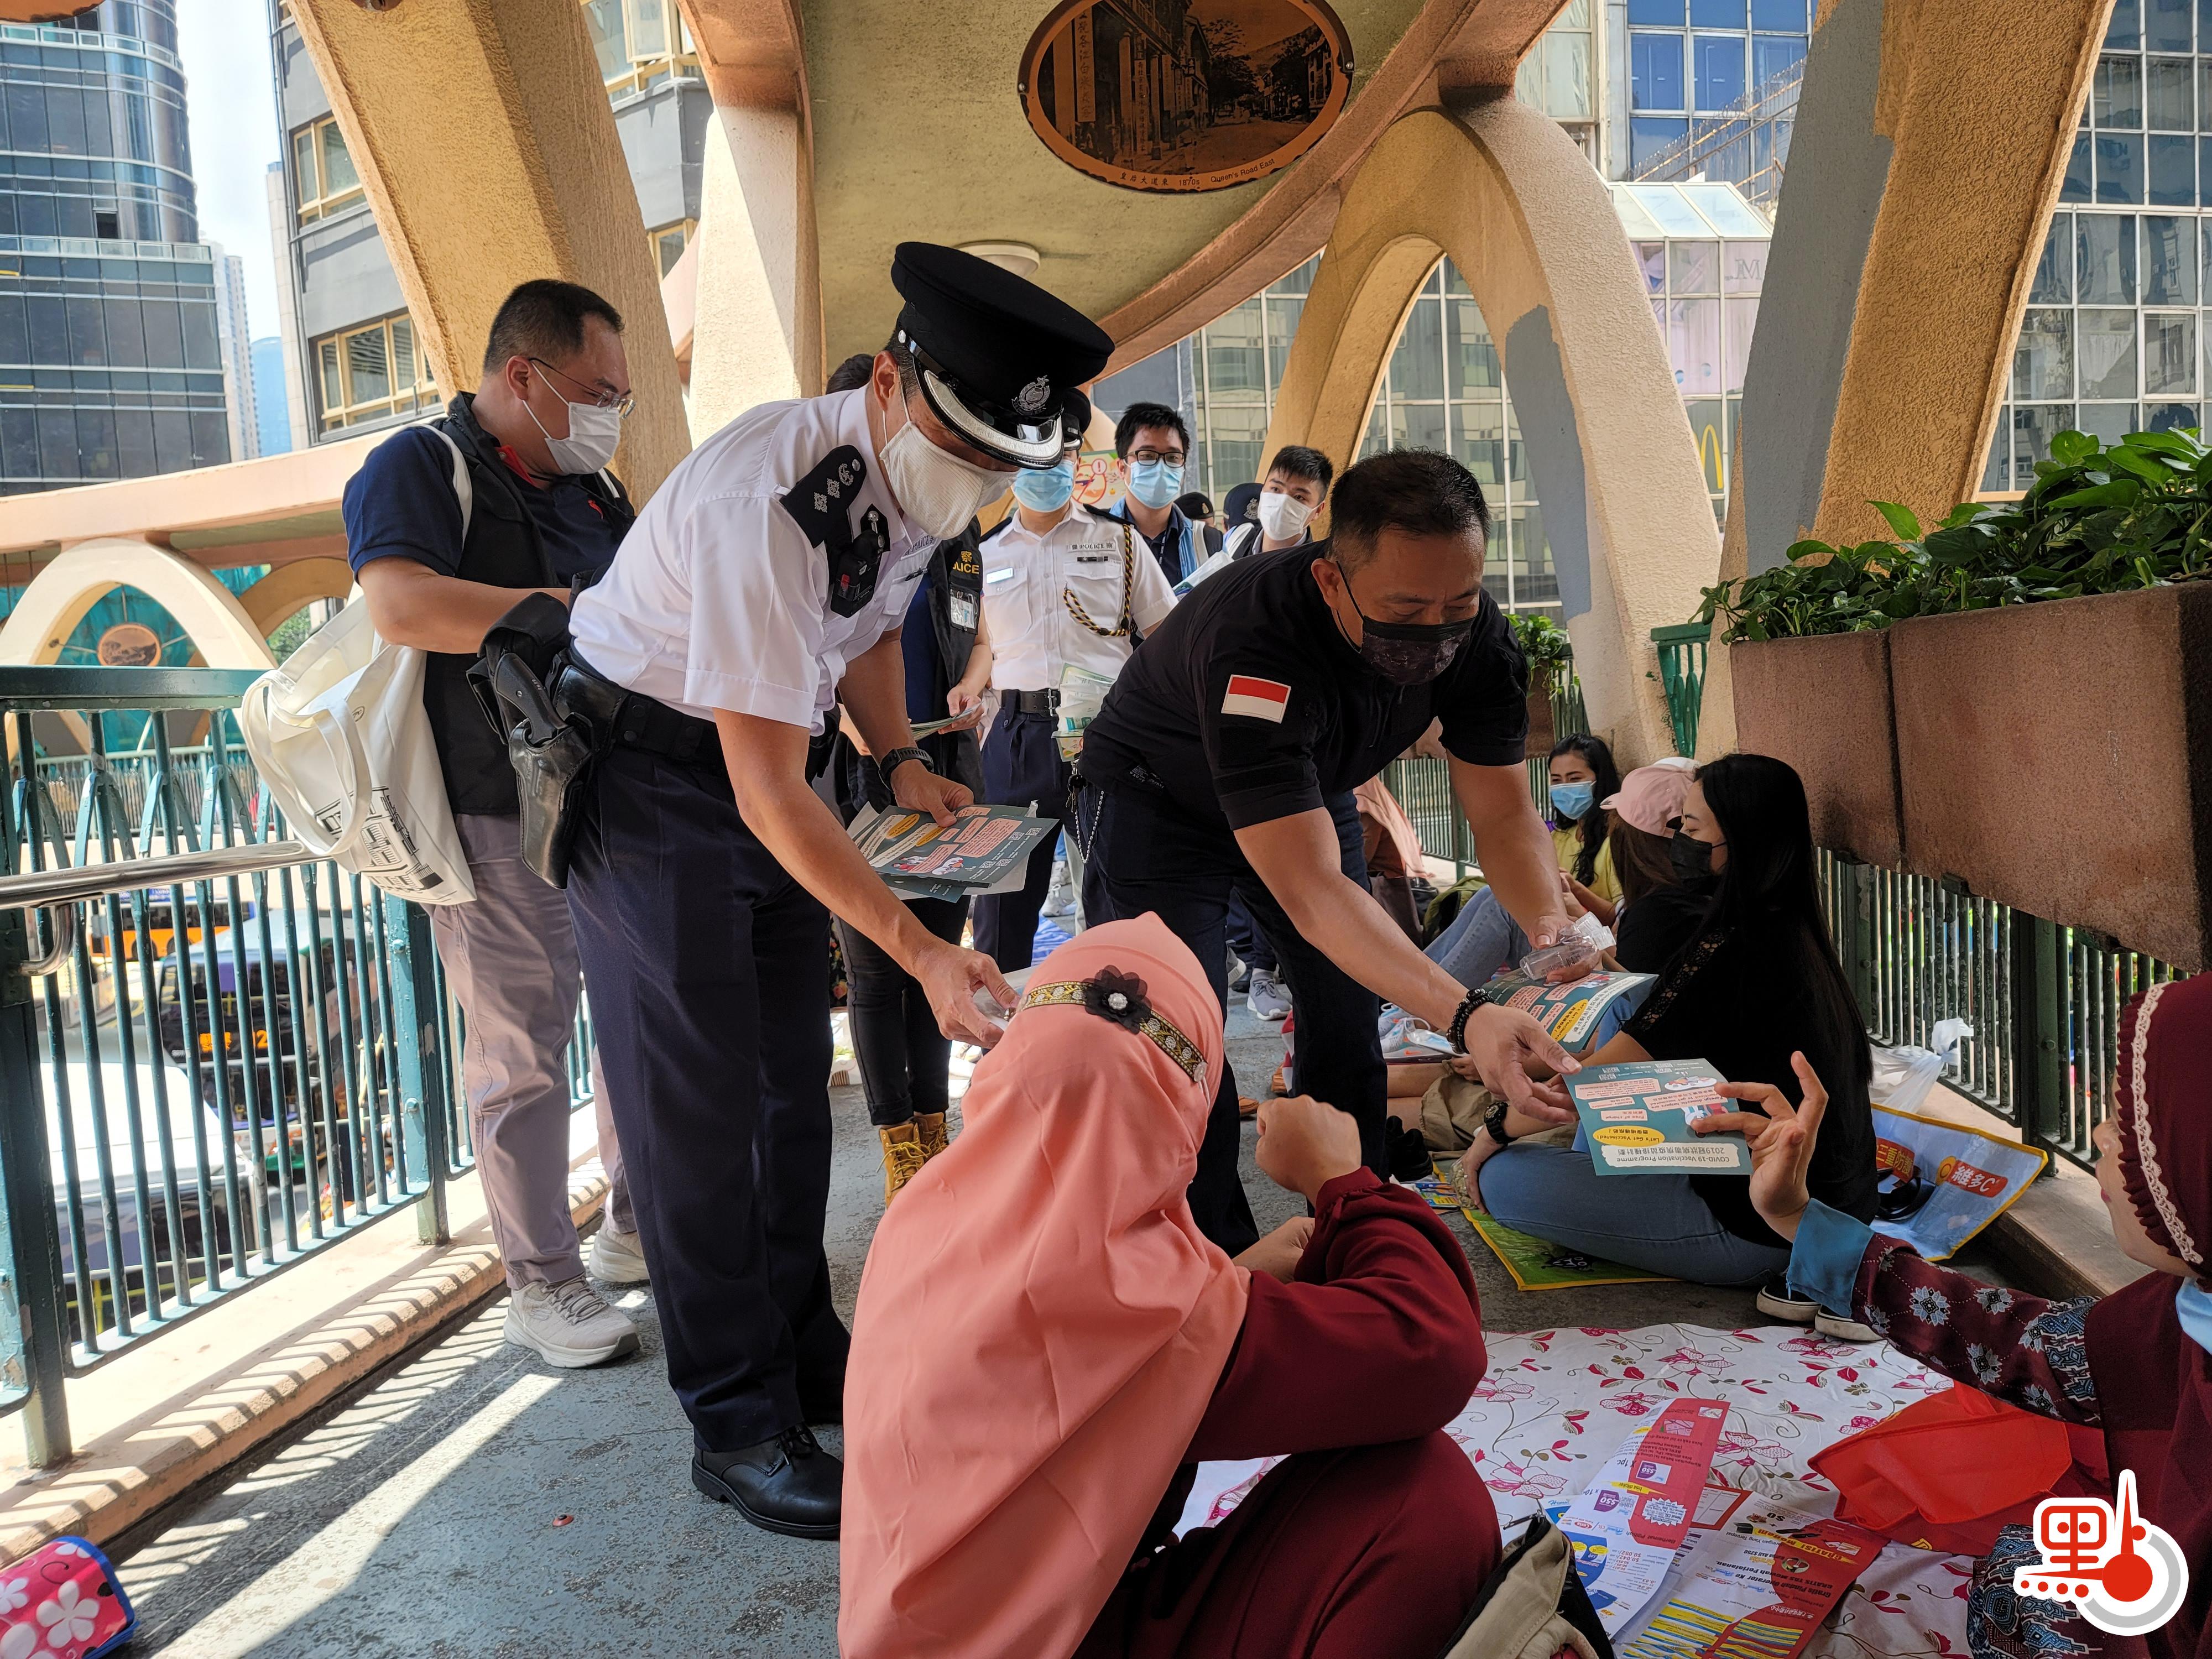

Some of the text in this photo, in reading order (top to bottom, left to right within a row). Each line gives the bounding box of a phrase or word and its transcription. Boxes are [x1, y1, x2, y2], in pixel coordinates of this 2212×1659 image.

[1211, 159, 1275, 183] Queen's Road East
[1120, 172, 1168, 186] 皇后大道東
[911, 535, 930, 552] POLICE
[961, 551, 972, 563] 察
[1875, 1144, 1912, 1178] 三重防護
[1715, 1561, 1759, 1574] Perjalanan.
[1806, 1585, 1832, 1598] Gratis
